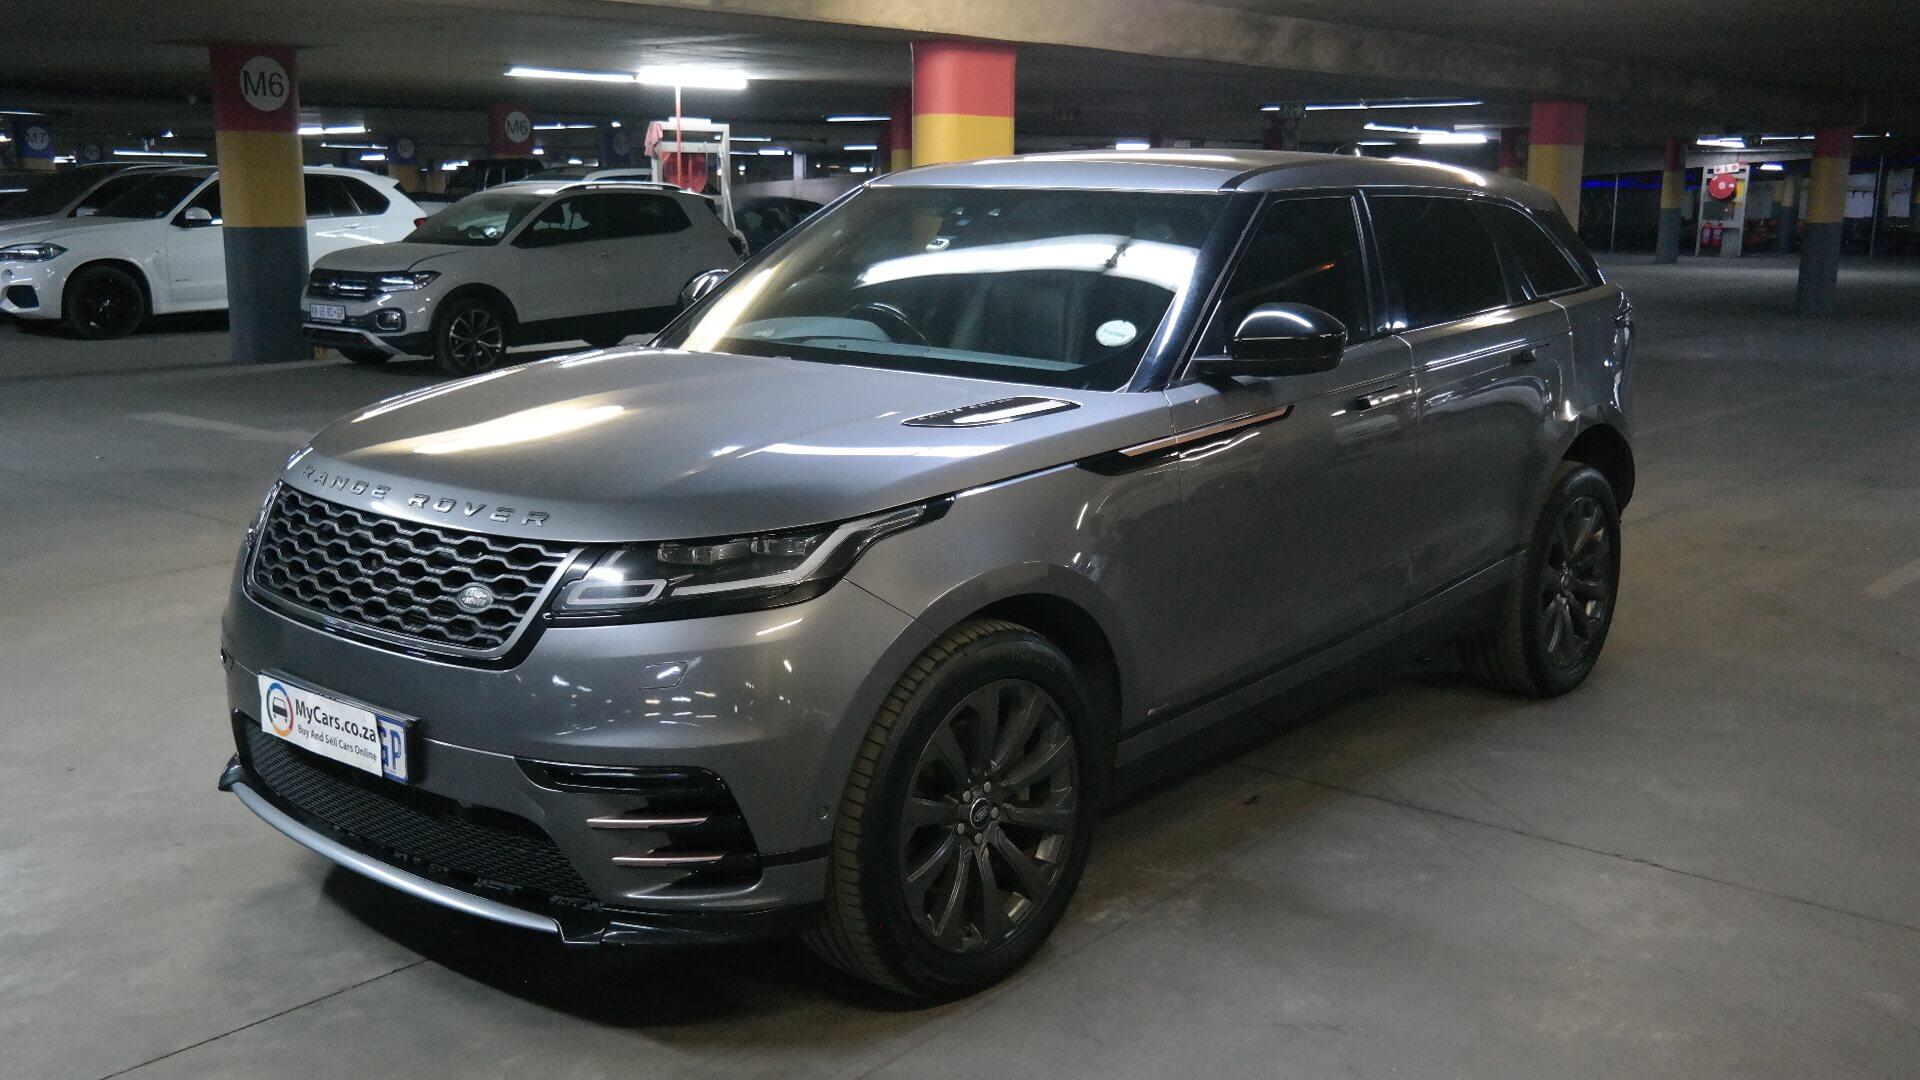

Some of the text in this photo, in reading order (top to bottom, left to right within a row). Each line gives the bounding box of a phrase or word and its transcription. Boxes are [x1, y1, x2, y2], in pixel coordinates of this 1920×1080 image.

[243, 70, 283, 97] M6
[507, 120, 528, 135] M6
[299, 463, 551, 527] RANGE ROVER
[295, 699, 376, 743] MyCars.co.za
[297, 724, 378, 761] Buy And Sell Cars Online
[379, 726, 402, 770] GP
